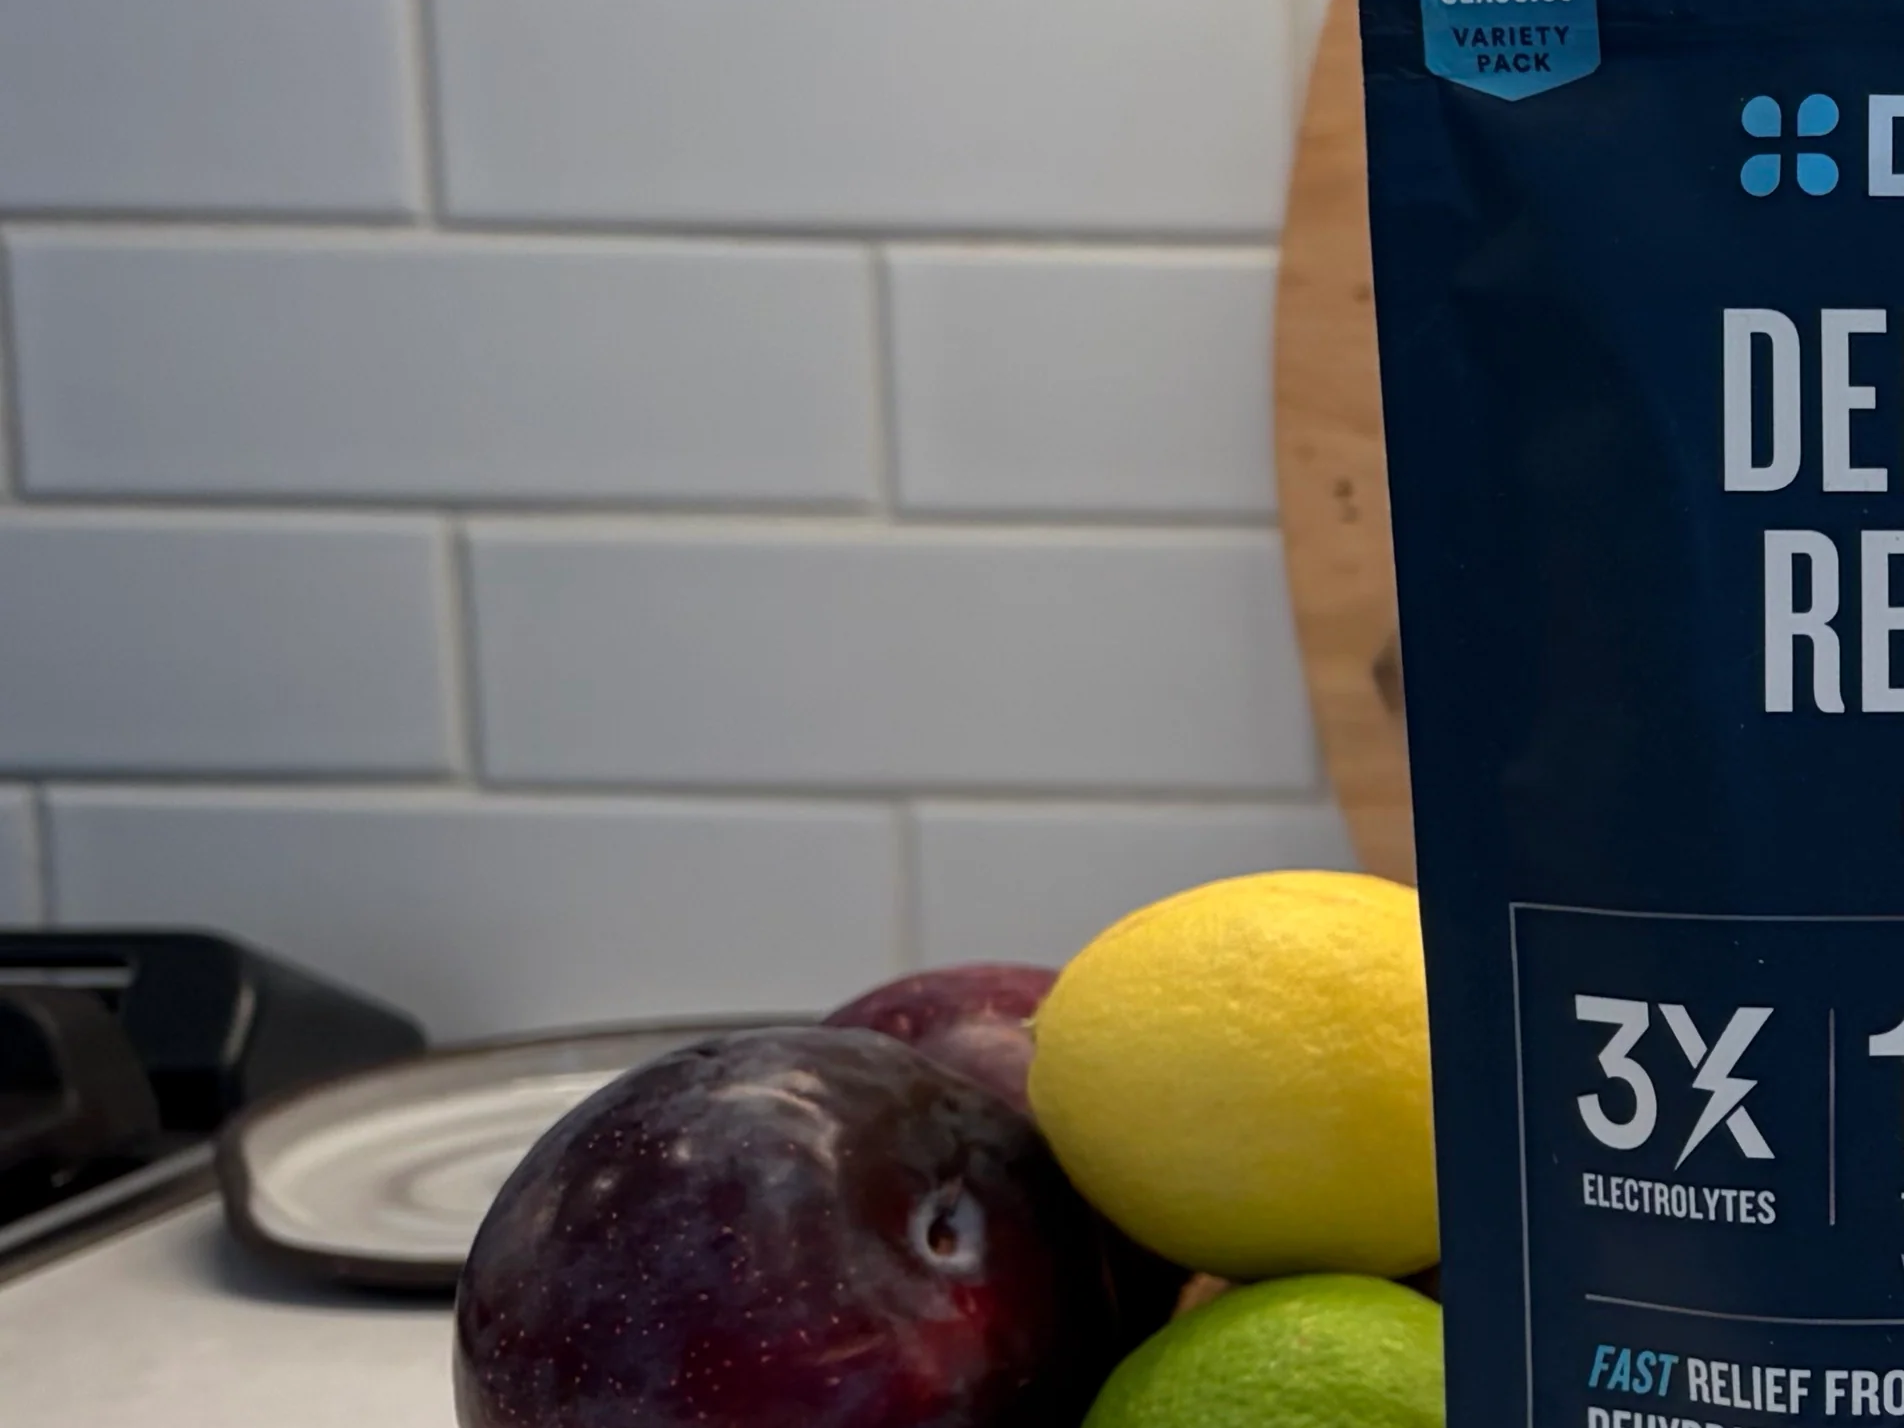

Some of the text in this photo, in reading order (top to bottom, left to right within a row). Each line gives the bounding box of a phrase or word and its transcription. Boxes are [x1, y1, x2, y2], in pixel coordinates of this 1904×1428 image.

[1453, 25, 1570, 47] VARIETY
[1477, 53, 1551, 72] PACK
[1574, 993, 1775, 1171] 3X
[1582, 1172, 1777, 1225] ELECTROLYTES
[1588, 1344, 1678, 1396] FAST
[1687, 1357, 1811, 1414] RELIEF
